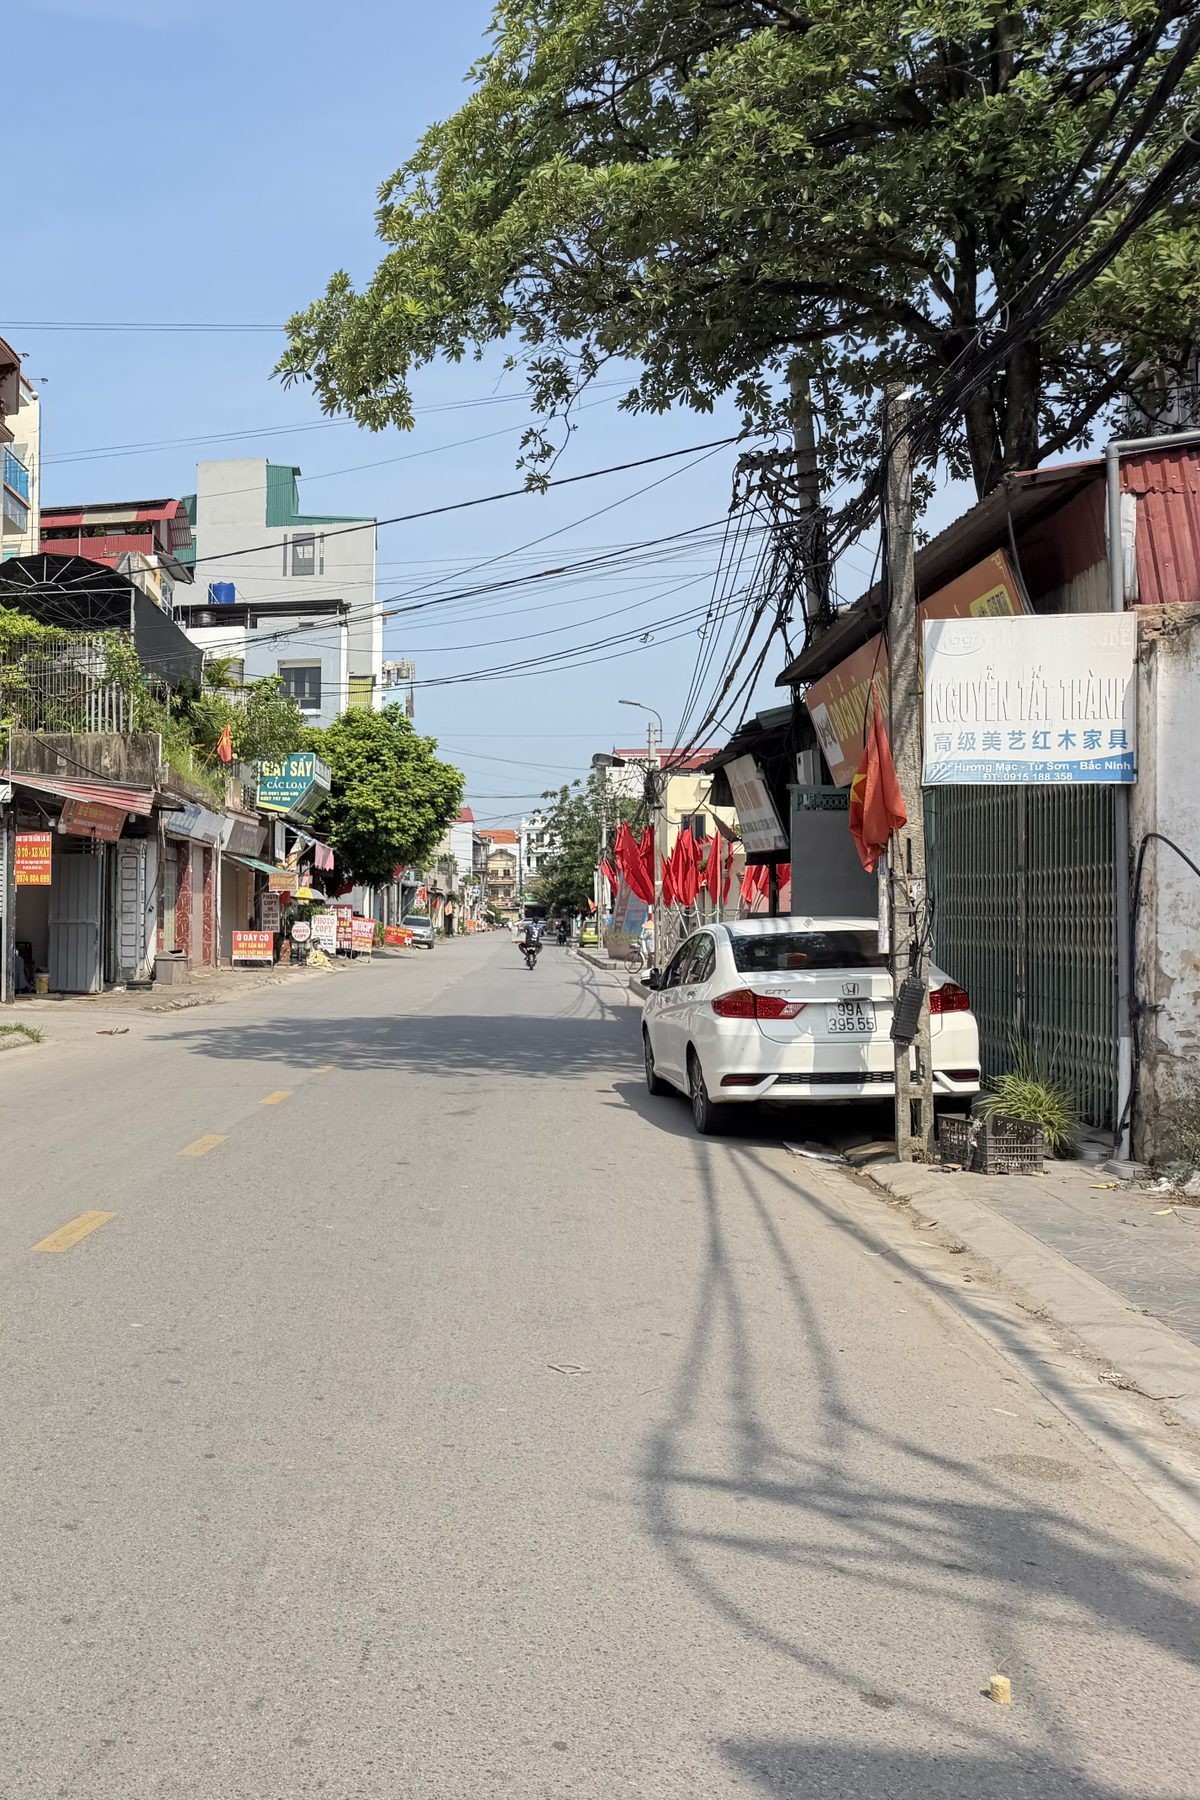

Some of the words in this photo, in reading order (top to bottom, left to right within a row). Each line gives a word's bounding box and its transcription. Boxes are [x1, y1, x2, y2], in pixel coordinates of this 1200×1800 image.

[930, 665, 1011, 723] NGUYỄN
[1017, 665, 1051, 720] TẤT
[1059, 669, 1128, 720] THÀNH
[933, 728, 1129, 753] 高级美艺红木家具
[290, 756, 313, 777] SẤY
[995, 762, 1018, 773] Mạc
[1046, 761, 1070, 771] Sơn
[1080, 760, 1101, 770] Bắc
[1104, 761, 1131, 770] Ninh
[1003, 773, 1029, 781] 0915
[1032, 773, 1051, 781] 188
[1054, 772, 1073, 780] 358
[266, 779, 285, 789] CÁC
[286, 781, 306, 791] LOẠI
[313, 917, 335, 925] PHOTO
[837, 1003, 863, 1017] 99A
[829, 1018, 875, 1032] 395.55
